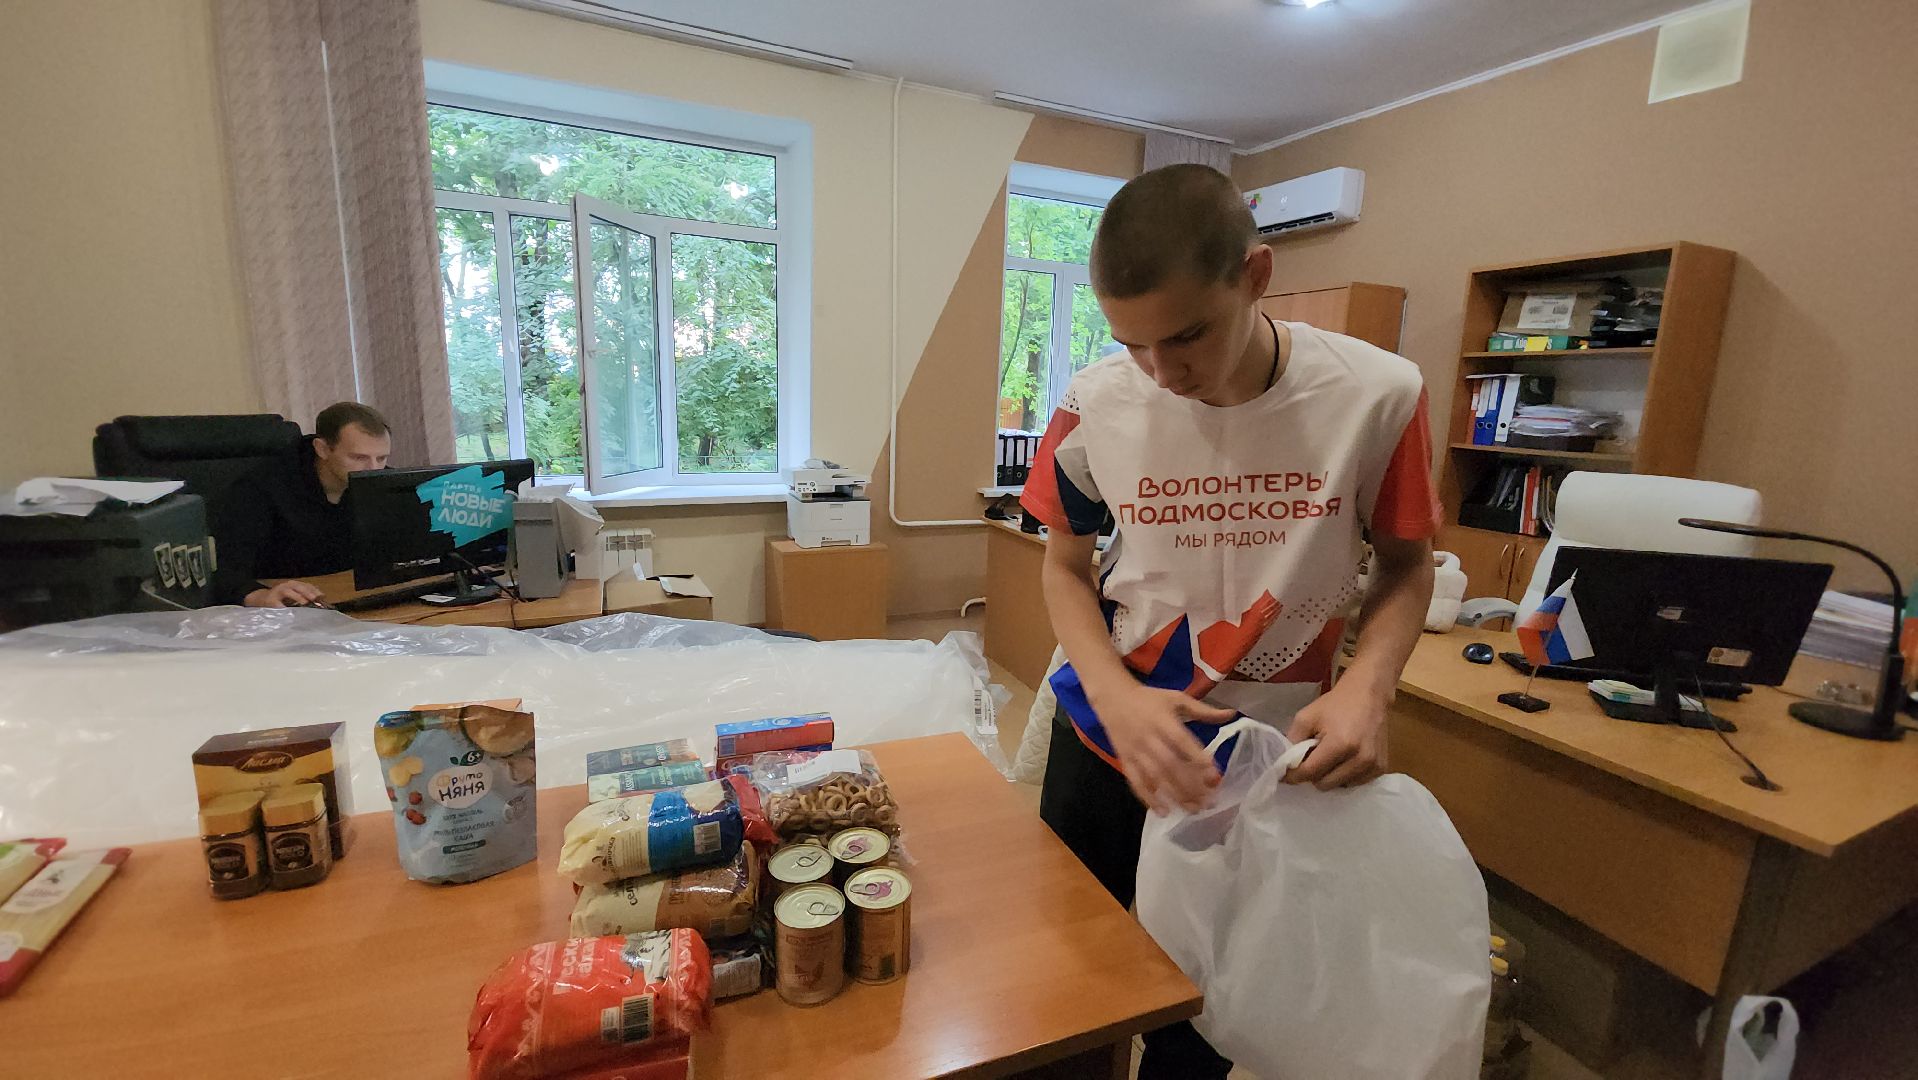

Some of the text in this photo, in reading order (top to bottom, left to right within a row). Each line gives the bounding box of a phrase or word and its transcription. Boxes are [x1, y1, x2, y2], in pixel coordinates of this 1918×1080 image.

[1138, 471, 1328, 499] ВОЛОНТЕРЫ
[441, 489, 505, 513] НОВЫЕ
[1119, 497, 1342, 525] ПОДМОСКОВЬЯ
[438, 508, 495, 528] ЛЮДИ
[1175, 530, 1286, 549] МЫ РЯДОМ
[466, 752, 481, 763] 6+
[438, 781, 485, 802] НЯНЯ
